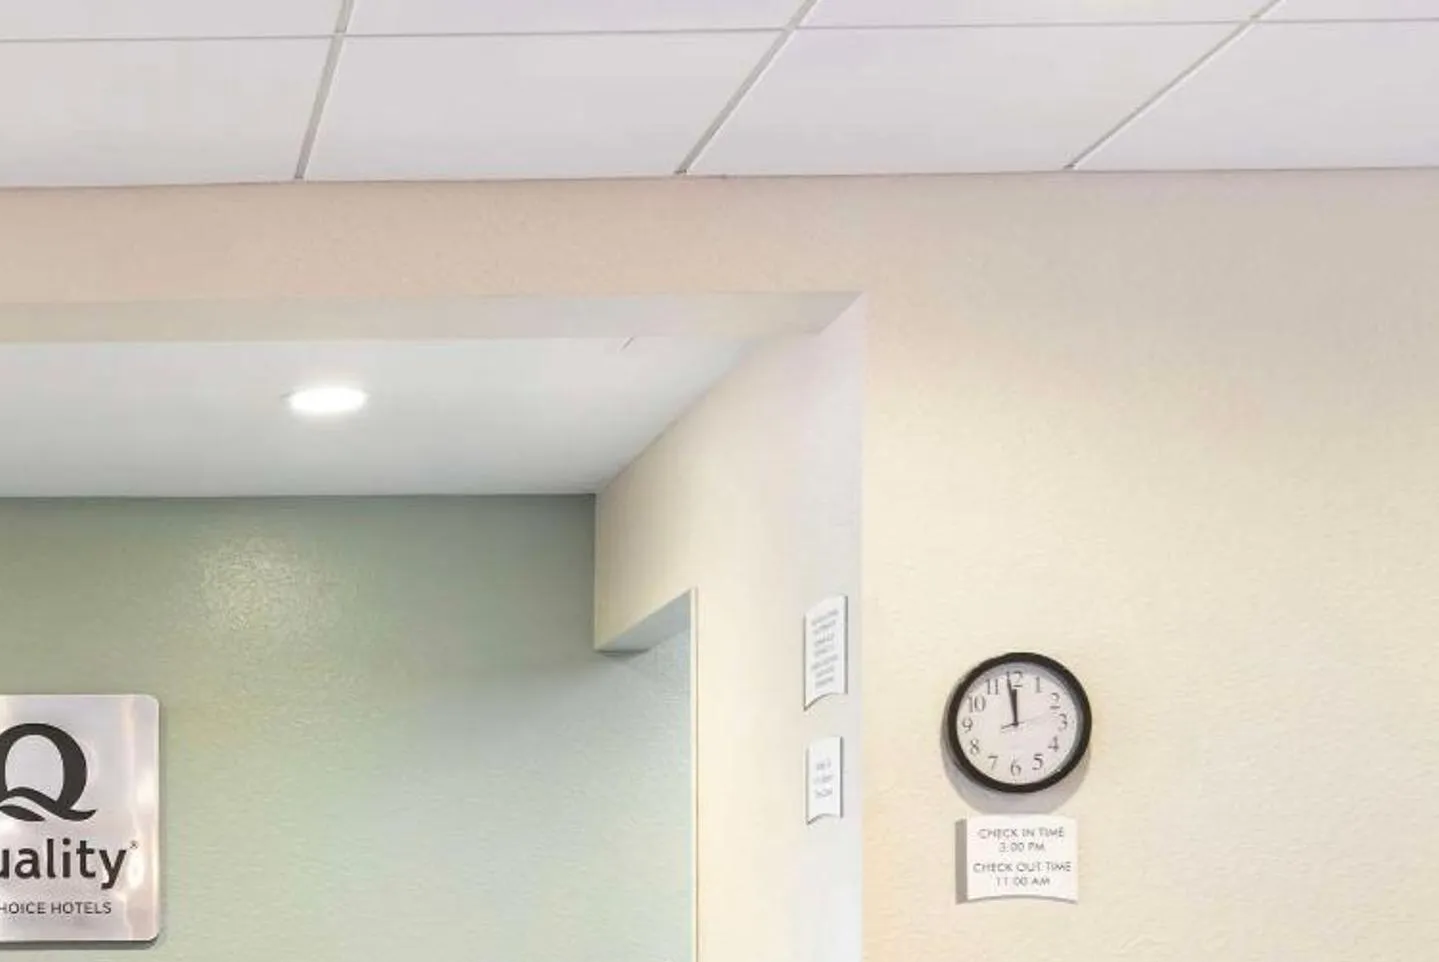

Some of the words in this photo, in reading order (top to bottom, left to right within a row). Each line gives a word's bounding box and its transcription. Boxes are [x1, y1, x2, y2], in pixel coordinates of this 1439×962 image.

[986, 679, 999, 695] 11
[1006, 671, 1023, 688] 12
[1034, 676, 1042, 694] 1
[968, 695, 986, 713] 10
[1049, 692, 1061, 710] 2
[962, 717, 973, 734] 9
[1058, 713, 1068, 733] 3
[969, 738, 980, 755] 8
[1047, 736, 1059, 753] 4
[988, 755, 998, 769] 7
[1010, 758, 1022, 776] 6
[1032, 753, 1044, 771] 5
[977, 828, 1018, 840] CHECK
[1022, 827, 1035, 838] IN
[1038, 826, 1065, 838] TIME
[1027, 842, 1045, 852] PM
[972, 862, 1013, 873] CHECK
[1016, 861, 1041, 872] OUT
[1044, 861, 1072, 872] TIME
[996, 876, 1028, 887] 1100
[1031, 876, 1051, 886] AM
[51, 901, 112, 915] HOTELS
